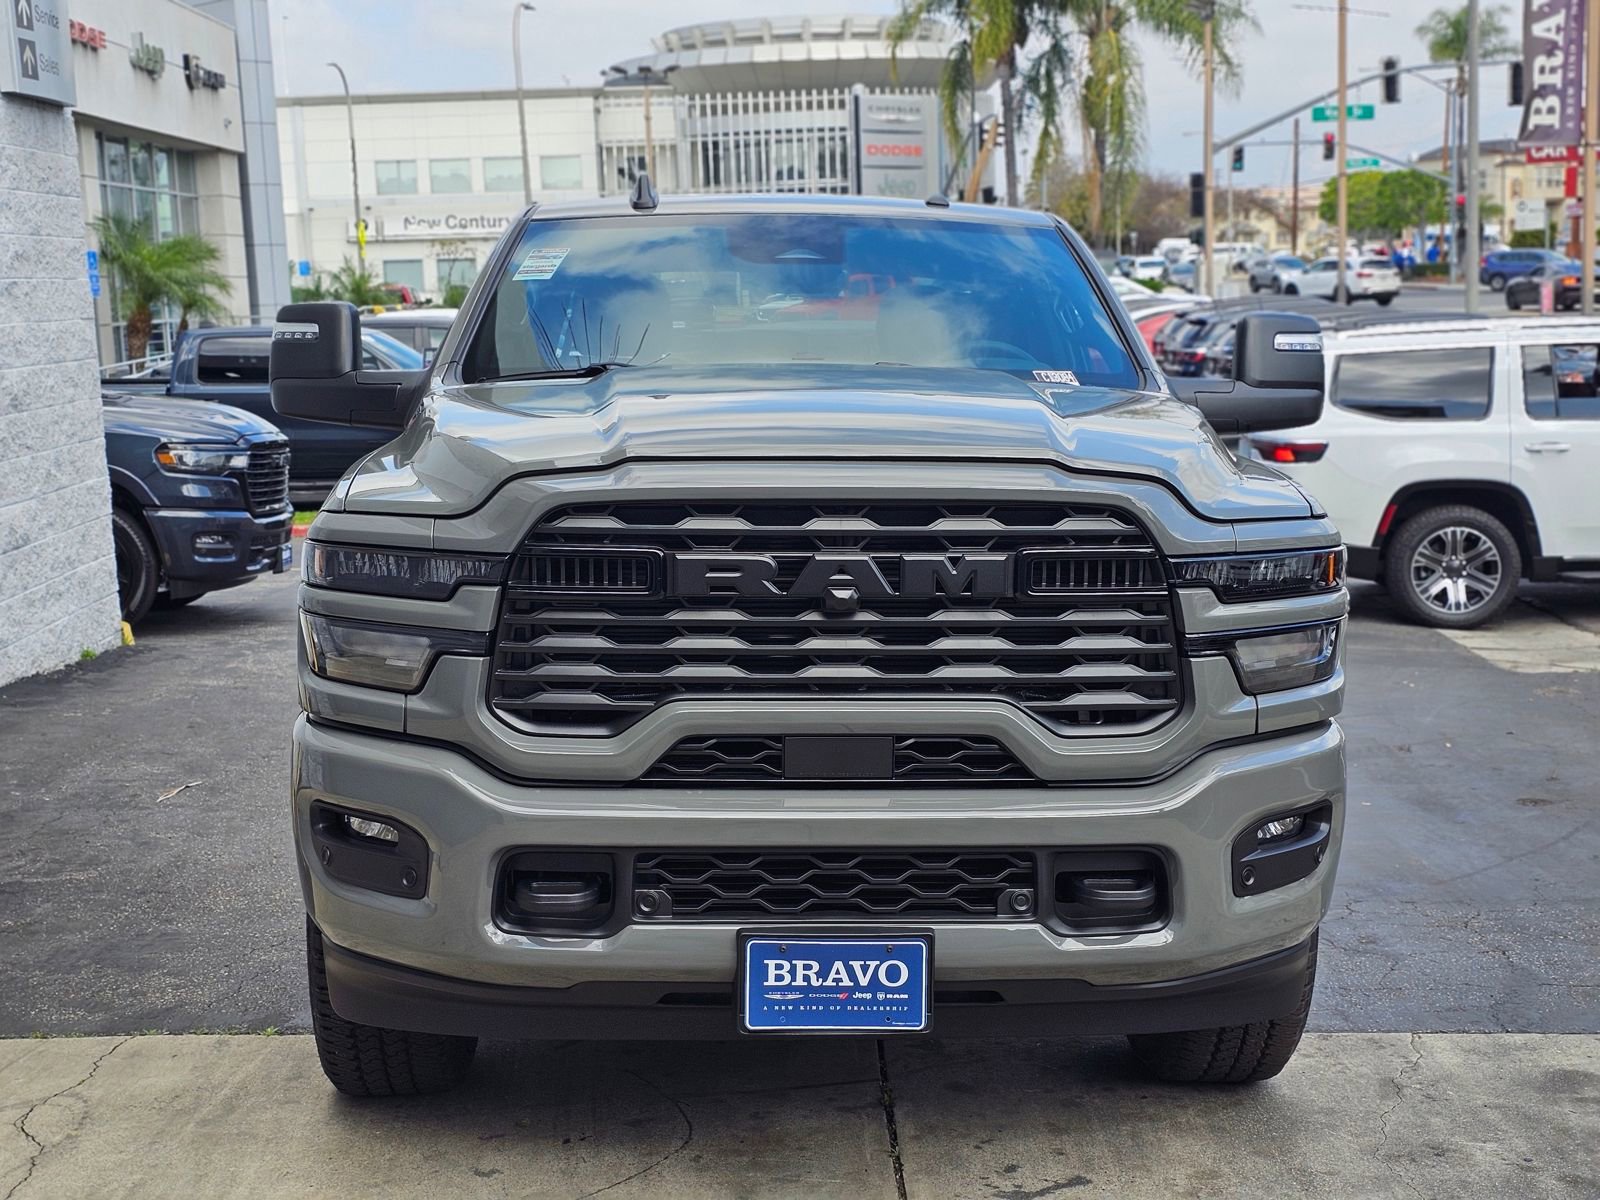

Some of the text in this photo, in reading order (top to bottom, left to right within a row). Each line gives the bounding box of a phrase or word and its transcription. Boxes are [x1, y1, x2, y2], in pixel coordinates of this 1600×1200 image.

[34, 4, 60, 29] Service
[39, 53, 60, 76] Sales
[866, 144, 923, 157] DODGE
[445, 214, 512, 230] Century
[674, 554, 1008, 598] RAM
[763, 959, 909, 987] BRAVO
[852, 991, 873, 1000] Jeep
